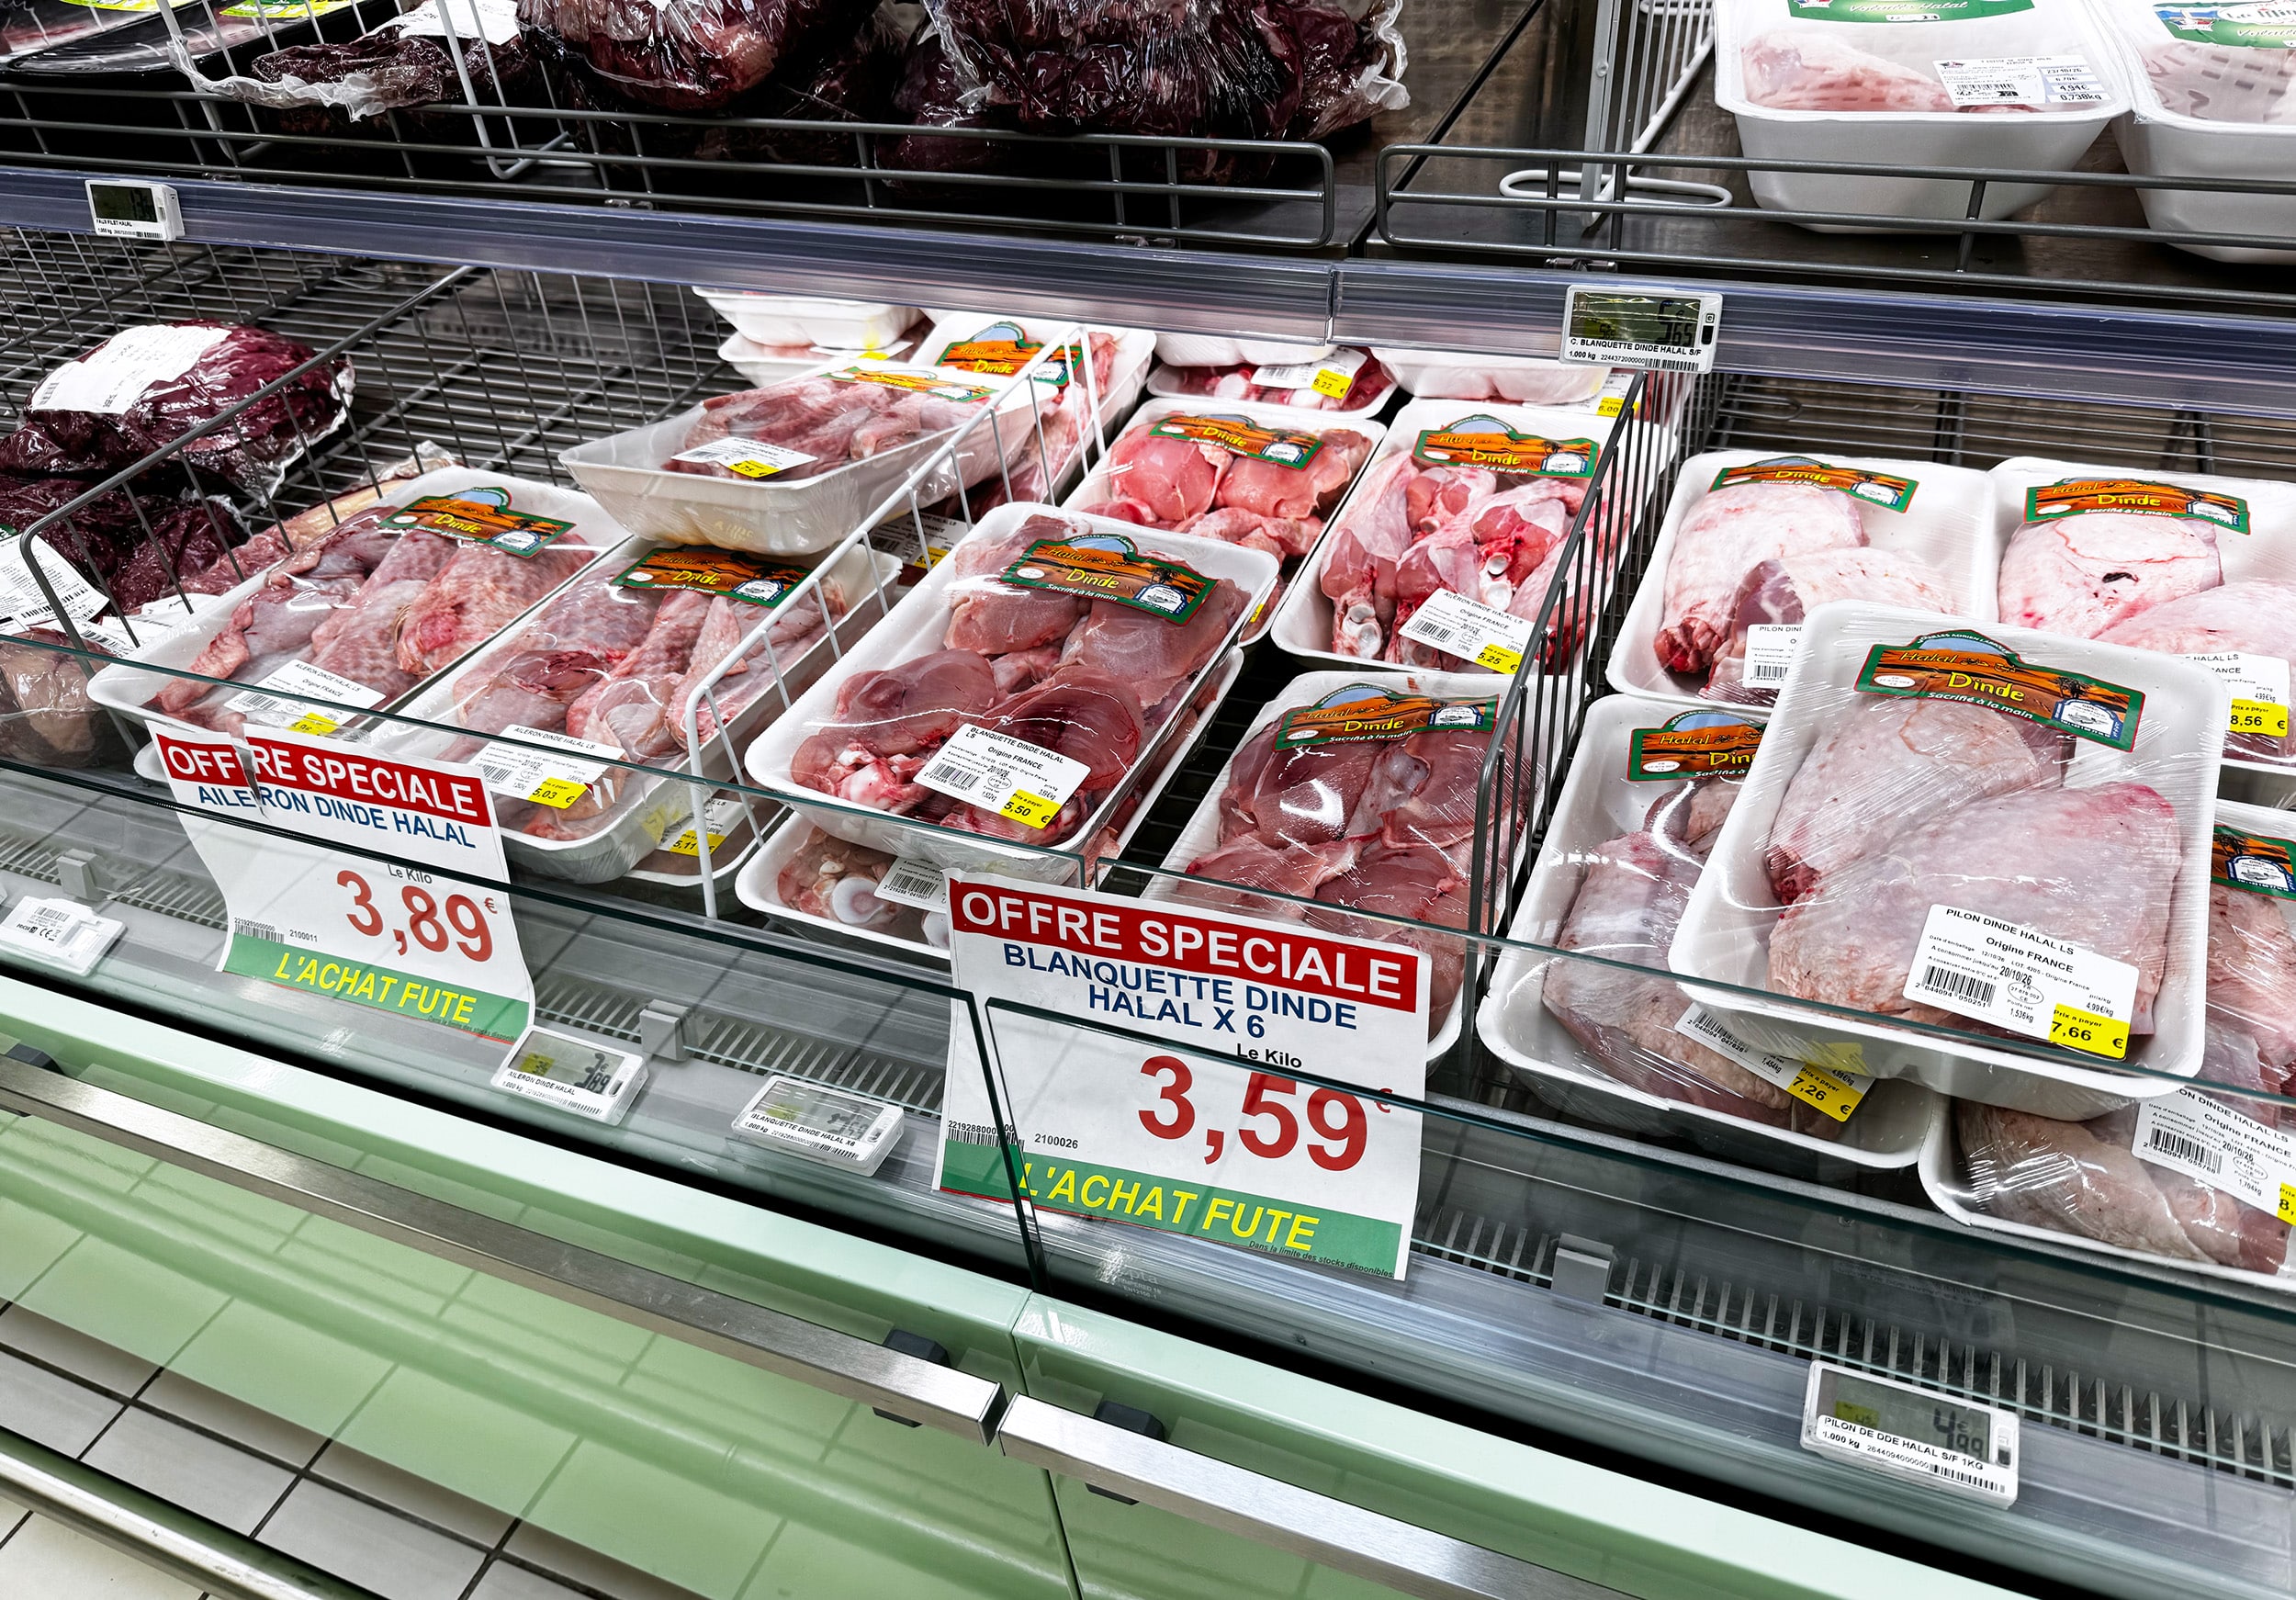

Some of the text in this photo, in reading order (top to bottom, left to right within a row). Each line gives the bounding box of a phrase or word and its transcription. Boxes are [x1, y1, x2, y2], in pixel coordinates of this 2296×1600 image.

[1581, 339, 1633, 351] BLANQUETTE
[1634, 344, 1659, 353] DINDE
[1660, 346, 1687, 355] HALAL
[1689, 348, 1702, 356] S/F
[1587, 351, 1596, 361] kg
[974, 360, 1014, 373] Dinde
[1314, 378, 1332, 390] 6,22
[1202, 426, 1248, 447] Dinde
[1471, 449, 1522, 466] Dinde
[1775, 470, 1832, 483] Dinde
[2052, 481, 2098, 494] Halal
[2097, 494, 2161, 507] Dinde
[433, 513, 482, 534] Dinde
[1046, 548, 1089, 562] Halal
[1066, 569, 1120, 589] Dinde
[1046, 583, 1077, 594] Sacrifié
[1096, 592, 1119, 602] main
[1444, 592, 1513, 620] AILERON DINDE HALAL
[1459, 608, 1510, 629] Origine FRANCE
[1478, 652, 1502, 665] 5,25
[1898, 650, 1958, 664] Halal
[1947, 671, 2025, 703] Dinde
[1307, 708, 1351, 720] Halal
[1928, 692, 2033, 720] Sacrifié la main
[1344, 718, 1404, 733] Dinde
[2230, 715, 2285, 729] 8,56 €
[514, 727, 585, 747] AILERON DINDE HALAL
[970, 727, 1064, 764] BLANQUETTE DINDE HALAL
[1329, 730, 1412, 743] Sacrifié main
[1660, 735, 1711, 745] Halal
[987, 746, 1043, 770] Origine FRANCE
[301, 753, 478, 817] SPECIALE
[533, 788, 557, 799] 5,03
[313, 795, 388, 829] DINDE
[392, 811, 477, 849] HALAL
[1004, 802, 1051, 823] 5,50 €
[673, 840, 696, 850] 5,11
[387, 863, 433, 885] Le Kilo
[336, 870, 499, 963] 3,89 €
[288, 929, 319, 942] 2100011
[1946, 908, 2074, 955] PILON DINDE HALAL LS
[961, 891, 1403, 1001] OFFRE SPECIALE
[2026, 951, 2074, 974] FRANCE
[1004, 942, 1358, 1031] BLANQUETTE DINDE
[1999, 966, 2032, 986] 20/10/26
[274, 952, 478, 1024] L'ACHAT FUTE
[2086, 1002, 2113, 1017] 4,99€/kg
[2089, 994, 2111, 1004] prix/kg
[1088, 984, 1266, 1039] HALAL X 6
[2054, 1009, 2102, 1027] Prix payer
[2052, 1020, 2123, 1049] 7,66 €
[1235, 1042, 1303, 1069] Le Kilo
[507, 1071, 576, 1096] AILERON DINDE HALAL
[1800, 1066, 1840, 1092] Prix payer
[1793, 1076, 1851, 1114] 7,26 €
[1137, 1055, 1368, 1173] 3,59
[2198, 1096, 2289, 1143] DINDE HALAL LS
[750, 1113, 798, 1132] BLANQUETTE
[797, 1126, 820, 1136] DINDE
[821, 1132, 844, 1144] HALAL
[948, 1120, 1078, 1148] 221928800000 2100026
[2223, 1141, 2254, 1162] 20/10/26
[2244, 1133, 2292, 1158] FRANCE
[1019, 1162, 1321, 1253] L'ACHAT FUTE
[1249, 1240, 1268, 1251] Dans
[1270, 1245, 1277, 1253] la
[1278, 1246, 1301, 1258] limite
[1302, 1252, 1317, 1262] des
[1318, 1256, 1345, 1268] stocks
[1822, 1431, 1929, 1470] 1.000 kg 2644094000000
[1824, 1416, 1984, 1470] PILON DE DDE HALAL S/F 1KG
